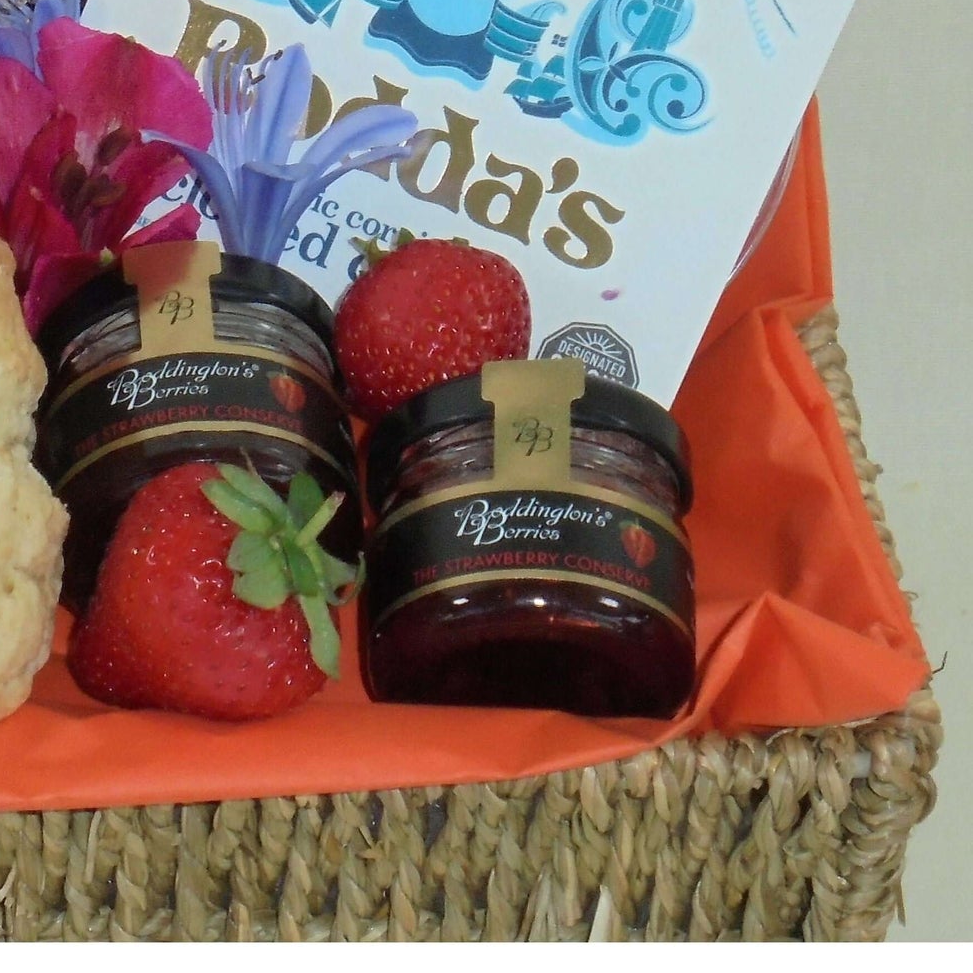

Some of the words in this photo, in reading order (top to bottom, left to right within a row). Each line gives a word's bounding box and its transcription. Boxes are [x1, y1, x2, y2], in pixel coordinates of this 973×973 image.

[558, 339, 627, 379] DESIGNATED
[127, 374, 210, 411] Berries
[101, 405, 209, 439] STRAWBERRY
[473, 507, 561, 546] Berries
[413, 566, 437, 584] THE
[443, 552, 560, 576] STRAWBERRY
[564, 553, 651, 590] CONSERVE
